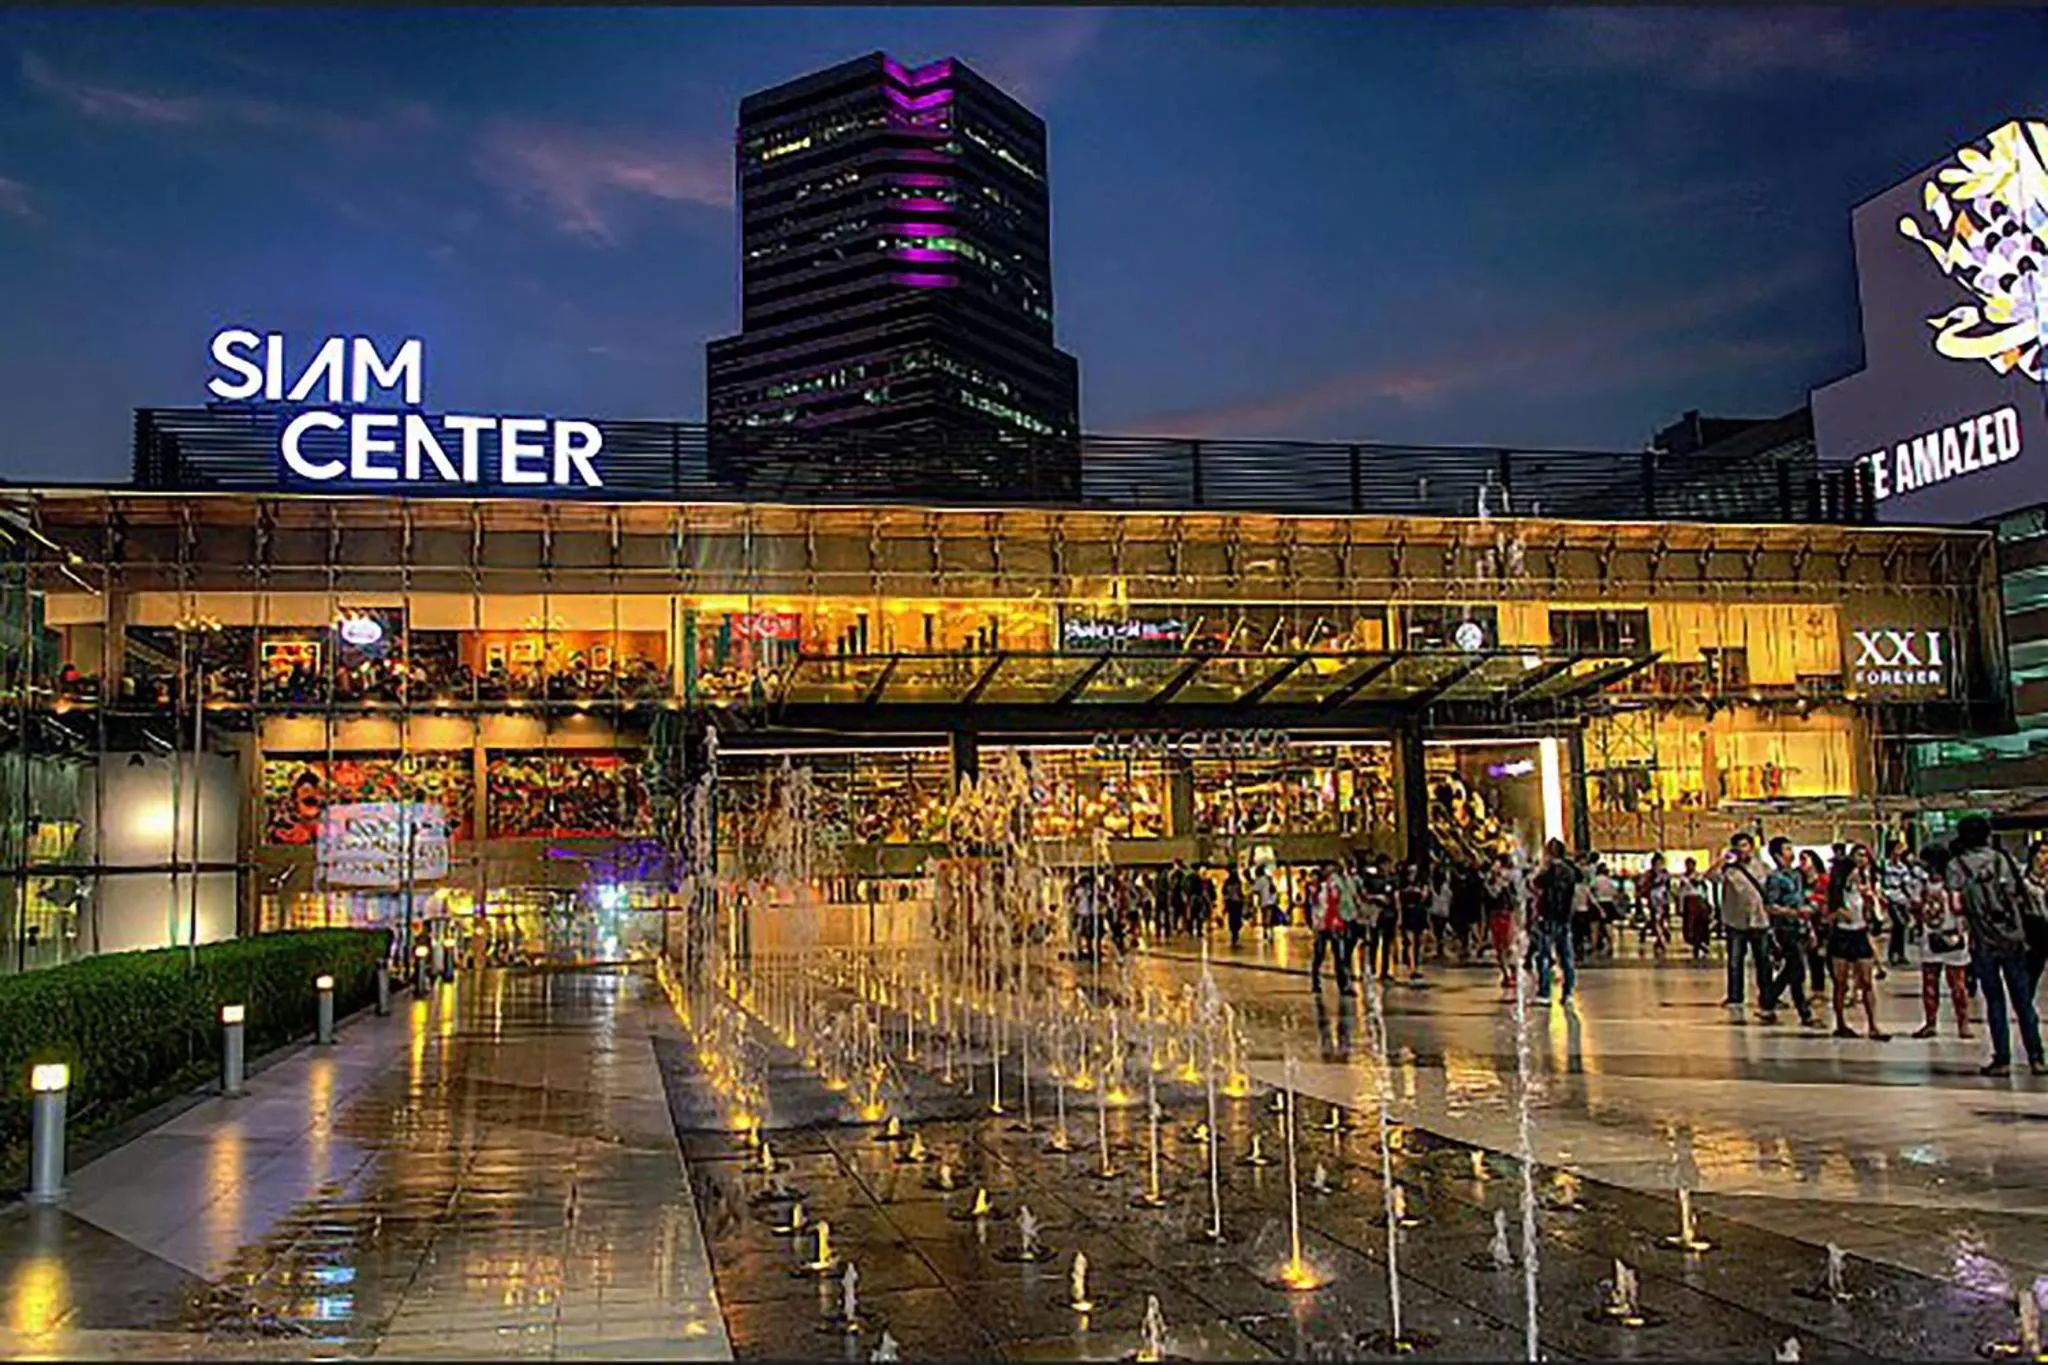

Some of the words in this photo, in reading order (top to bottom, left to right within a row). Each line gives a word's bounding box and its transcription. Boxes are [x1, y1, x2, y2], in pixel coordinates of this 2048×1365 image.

[207, 329, 422, 404] SIAM
[282, 411, 604, 487] CENTER
[1895, 407, 2021, 494] AMAZED
[1853, 631, 1944, 666] XXI
[1855, 670, 1941, 685] FOREVER
